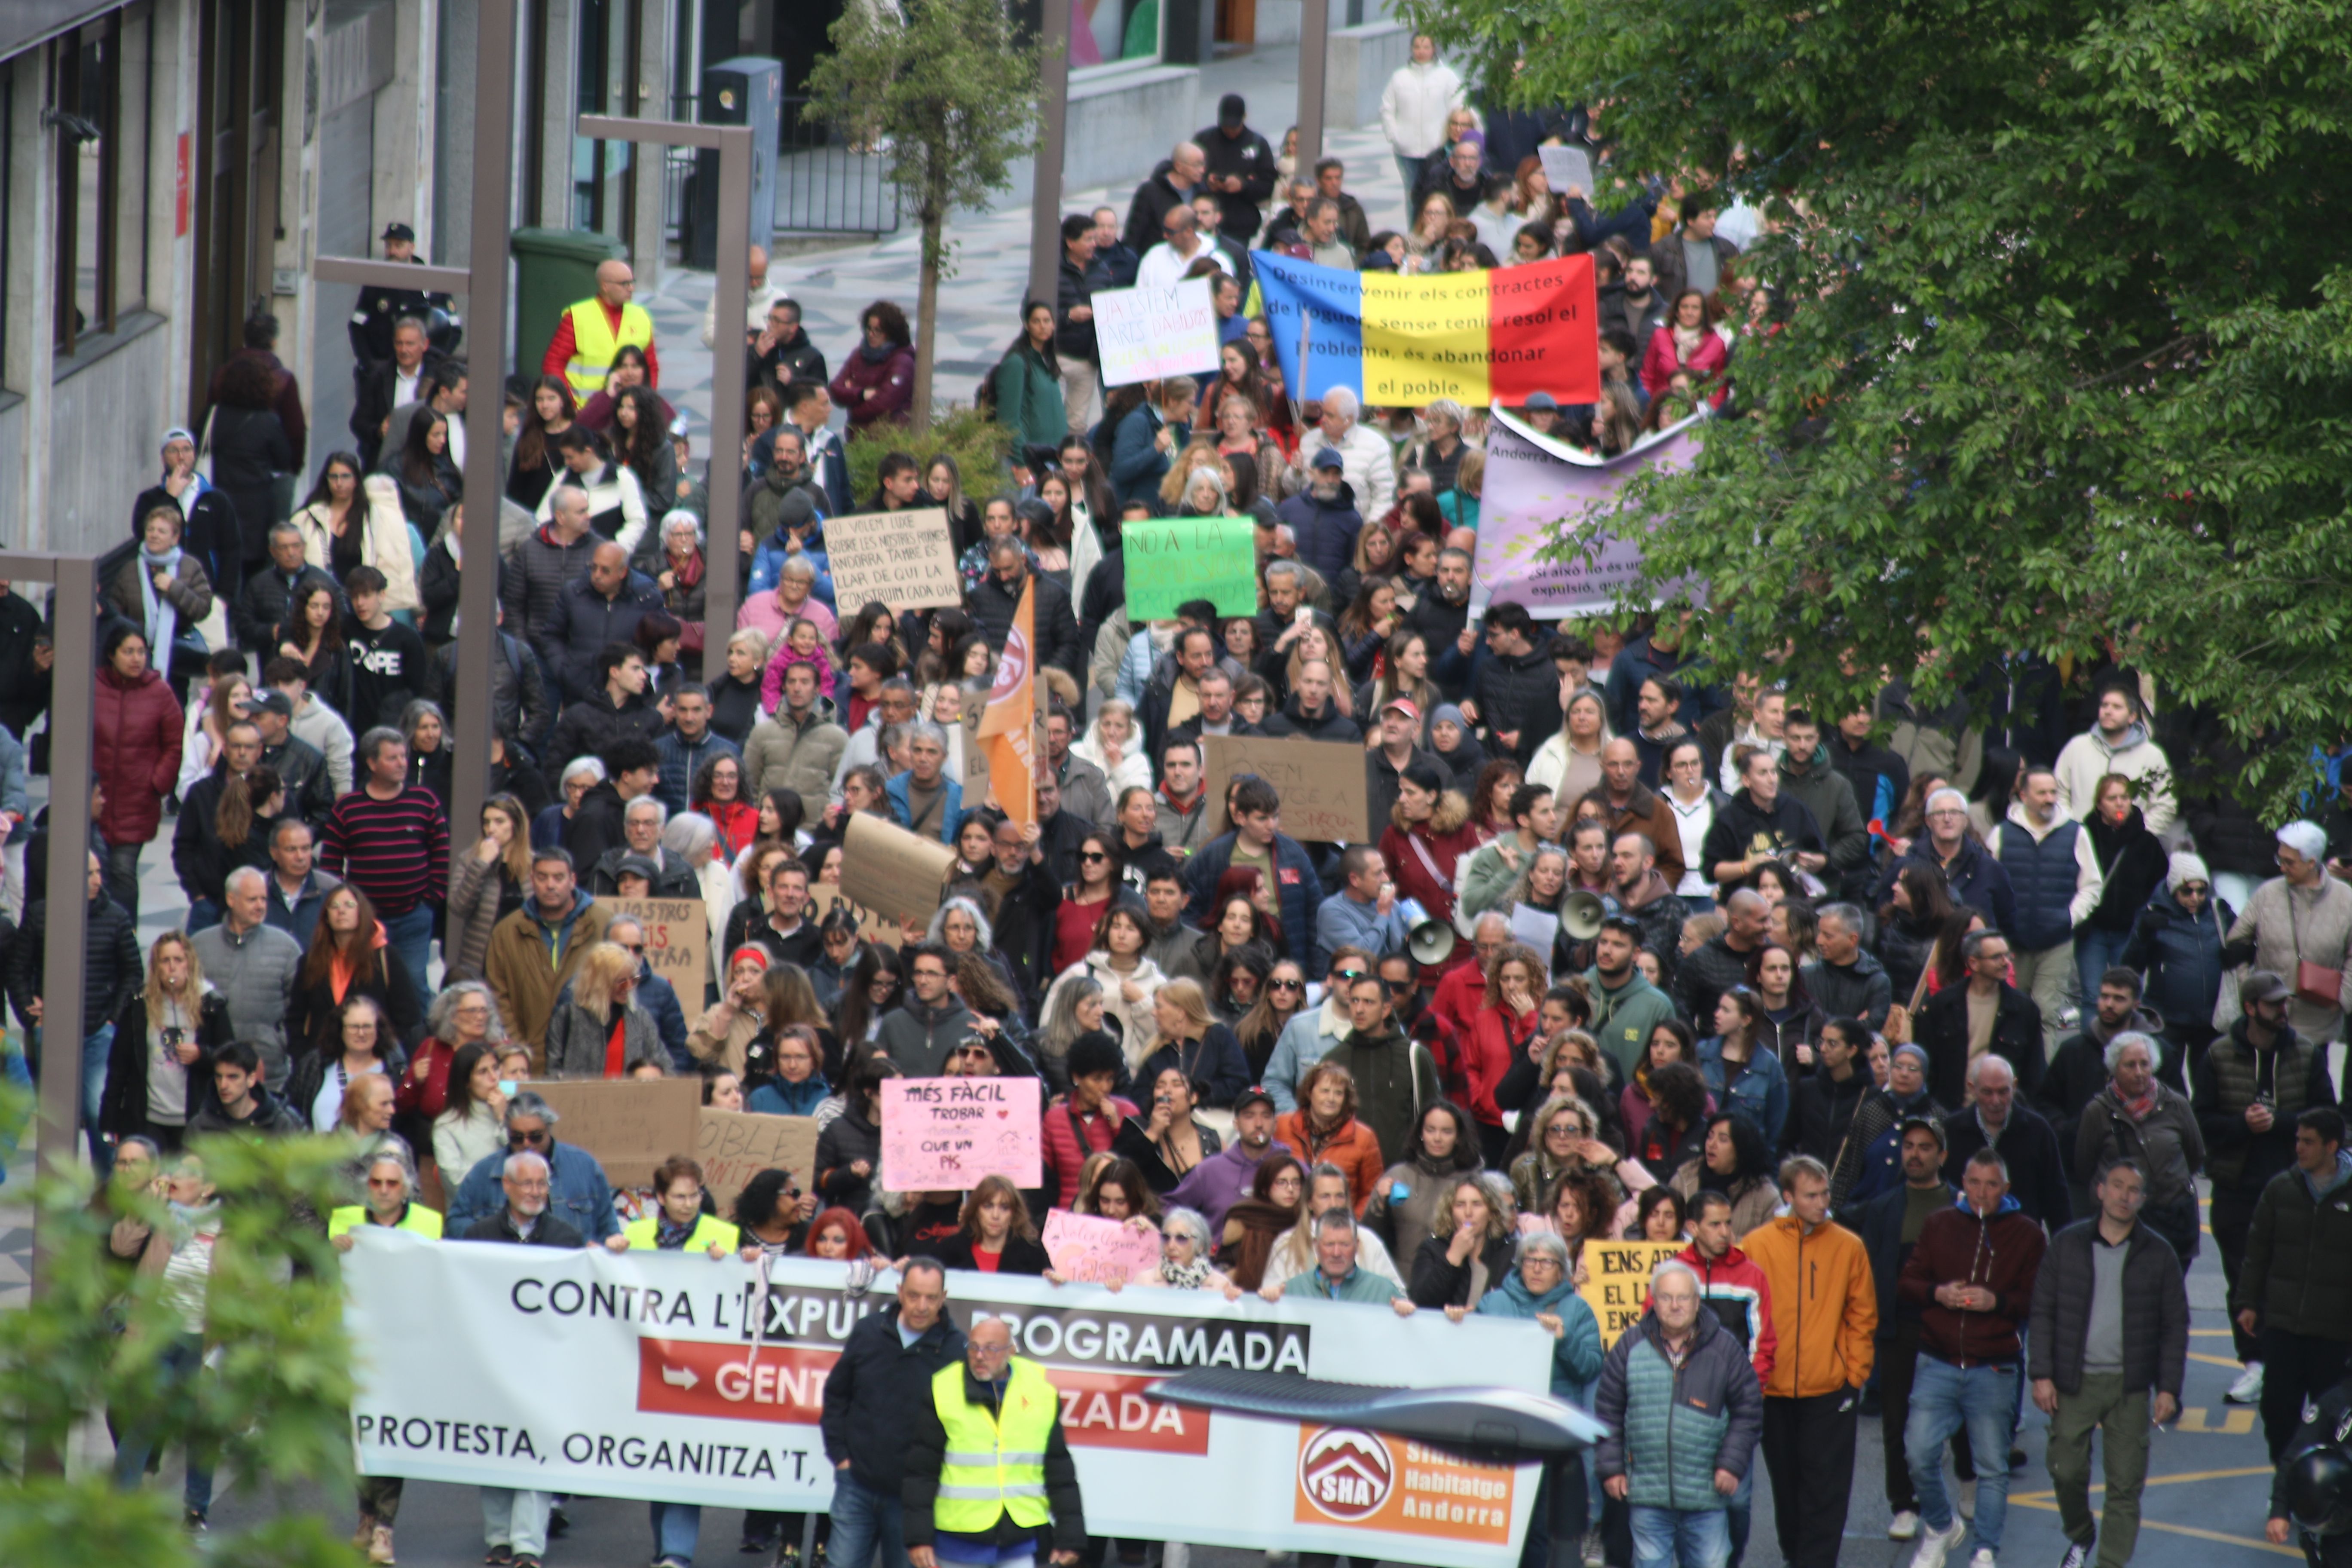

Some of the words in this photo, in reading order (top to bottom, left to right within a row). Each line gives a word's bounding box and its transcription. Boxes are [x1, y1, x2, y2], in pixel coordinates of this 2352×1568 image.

[1273, 266, 1412, 301] Desintervenir
[1419, 288, 1447, 301] els
[1455, 275, 1563, 300] contractes
[1126, 288, 1179, 317] ESTEM
[1268, 300, 1290, 315] de
[1379, 318, 1436, 330] sense
[1446, 314, 1494, 330] tenir
[1504, 308, 1552, 328] resol
[1559, 304, 1577, 321] el
[1432, 345, 1546, 364] abandonar
[1378, 380, 1393, 395] el
[1403, 380, 1464, 398] poble.
[1491, 446, 1547, 463] Andorra
[824, 521, 842, 536] NO
[848, 518, 884, 533] VOLEM
[890, 514, 915, 530] LUXE
[827, 539, 858, 555] SOBRE
[860, 536, 877, 551] LES
[1130, 530, 1158, 554] NO
[1164, 529, 1180, 552] A
[1195, 523, 1224, 550] LA
[831, 553, 884, 570] ANDORRA
[834, 572, 869, 589] LLAR
[872, 569, 891, 584] DE
[894, 567, 919, 580] QUI
[925, 565, 942, 578] LA
[838, 587, 903, 609] CONSTRUIM
[906, 585, 933, 600] CADA
[936, 584, 959, 597] DIA
[1531, 583, 1595, 597] expulsió,
[931, 1107, 984, 1120] TROBAR
[698, 1118, 799, 1162] OBLE
[921, 1140, 949, 1152] QUE
[955, 1140, 973, 1151] UN
[1600, 1250, 1643, 1275] ENS
[511, 1278, 696, 1328] CONTRA
[1604, 1285, 1626, 1305] EL
[1606, 1311, 1640, 1331] ENS
[356, 1415, 548, 1466] PROTESTA,
[562, 1433, 816, 1487] ORGANITZA'T,
[1321, 1474, 1370, 1506] SHA
[1404, 1468, 1507, 1501] Habitatge
[1402, 1496, 1504, 1528] Andorra
